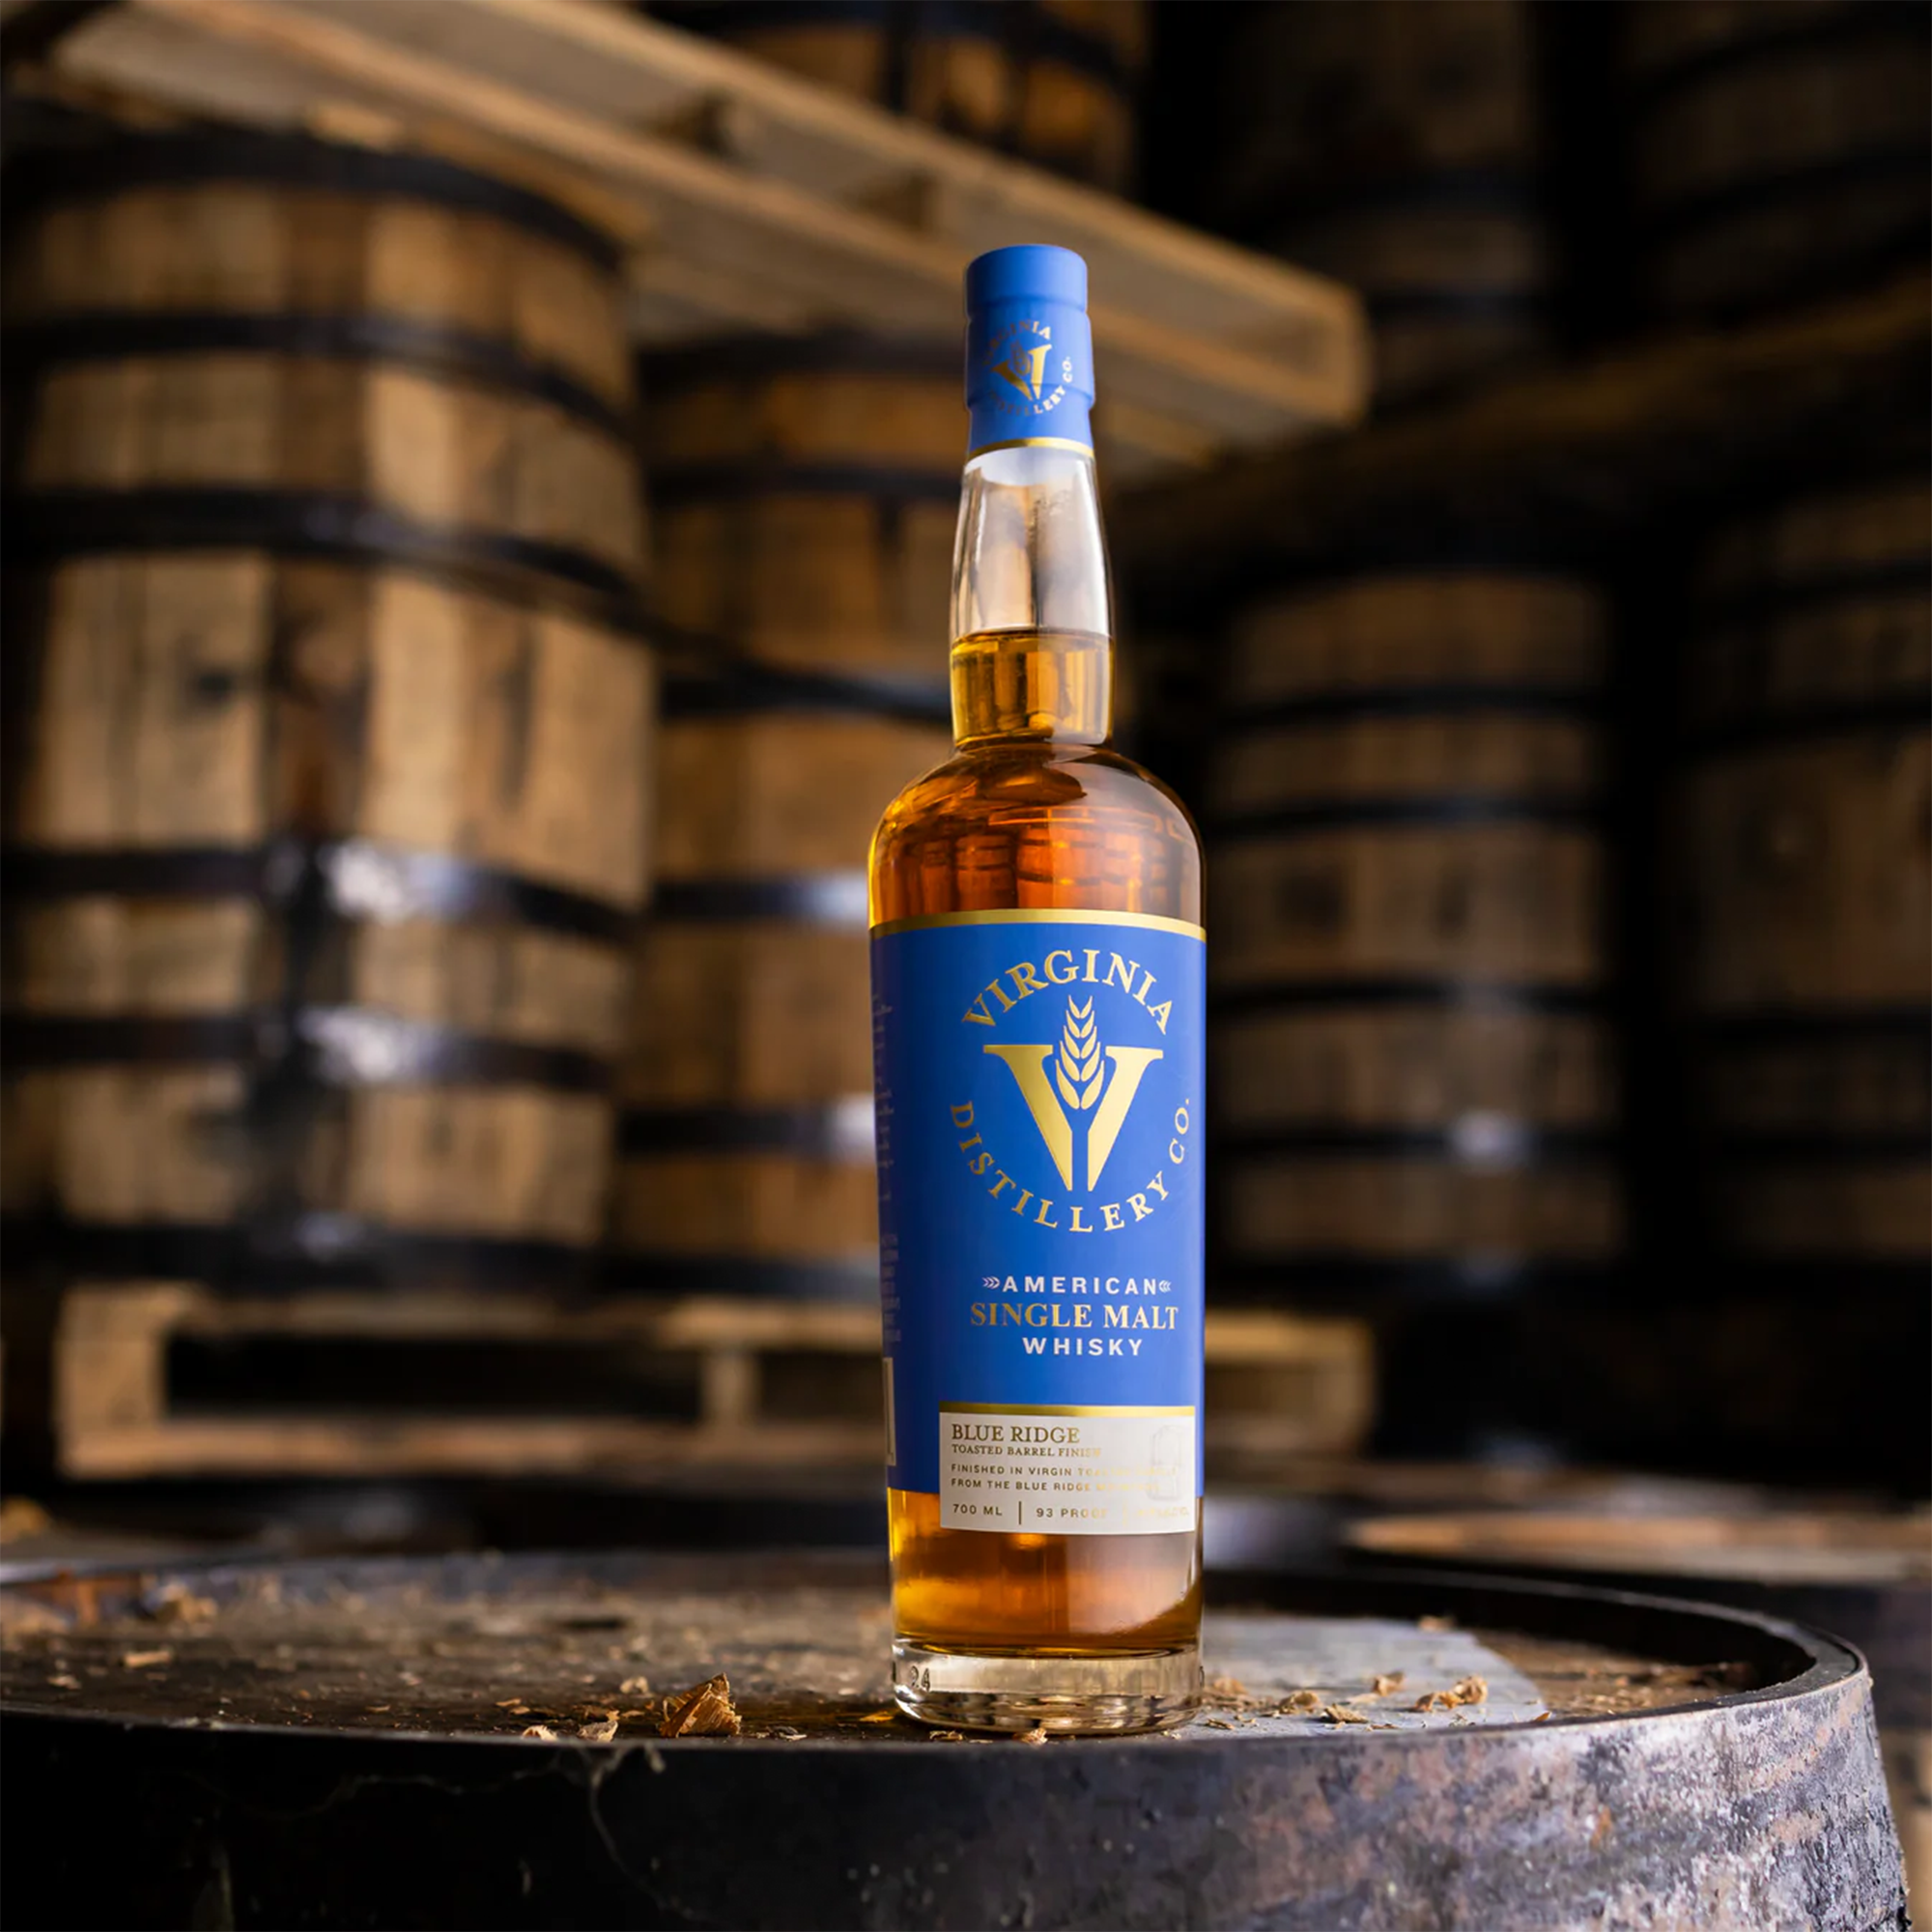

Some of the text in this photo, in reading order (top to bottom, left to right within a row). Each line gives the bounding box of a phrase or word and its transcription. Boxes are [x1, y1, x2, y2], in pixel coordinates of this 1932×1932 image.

[1062, 356, 1073, 383] CO.
[961, 949, 1173, 1036] VIRGINIA
[951, 1100, 1170, 1234] DISTILLERY
[1169, 1097, 1191, 1164] CO.
[1002, 1275, 1157, 1295] AMERICAN
[970, 1302, 1179, 1330] SINGLE MALT
[1022, 1337, 1143, 1356] WHISKY
[952, 1424, 1081, 1444] BLUE RIDGE
[952, 1444, 1102, 1458] TOASTED BARREL FINISH
[952, 1463, 1006, 1475] FINISHED
[1010, 1465, 1023, 1475] IN
[1030, 1466, 1072, 1477] VIRGIN
[952, 1478, 982, 1489] FROM
[987, 1480, 1010, 1491] THE
[1015, 1481, 1048, 1492] BLUE
[1054, 1482, 1091, 1492] RIDGE
[952, 1503, 1110, 1520] 700 ML 93 PROOF
